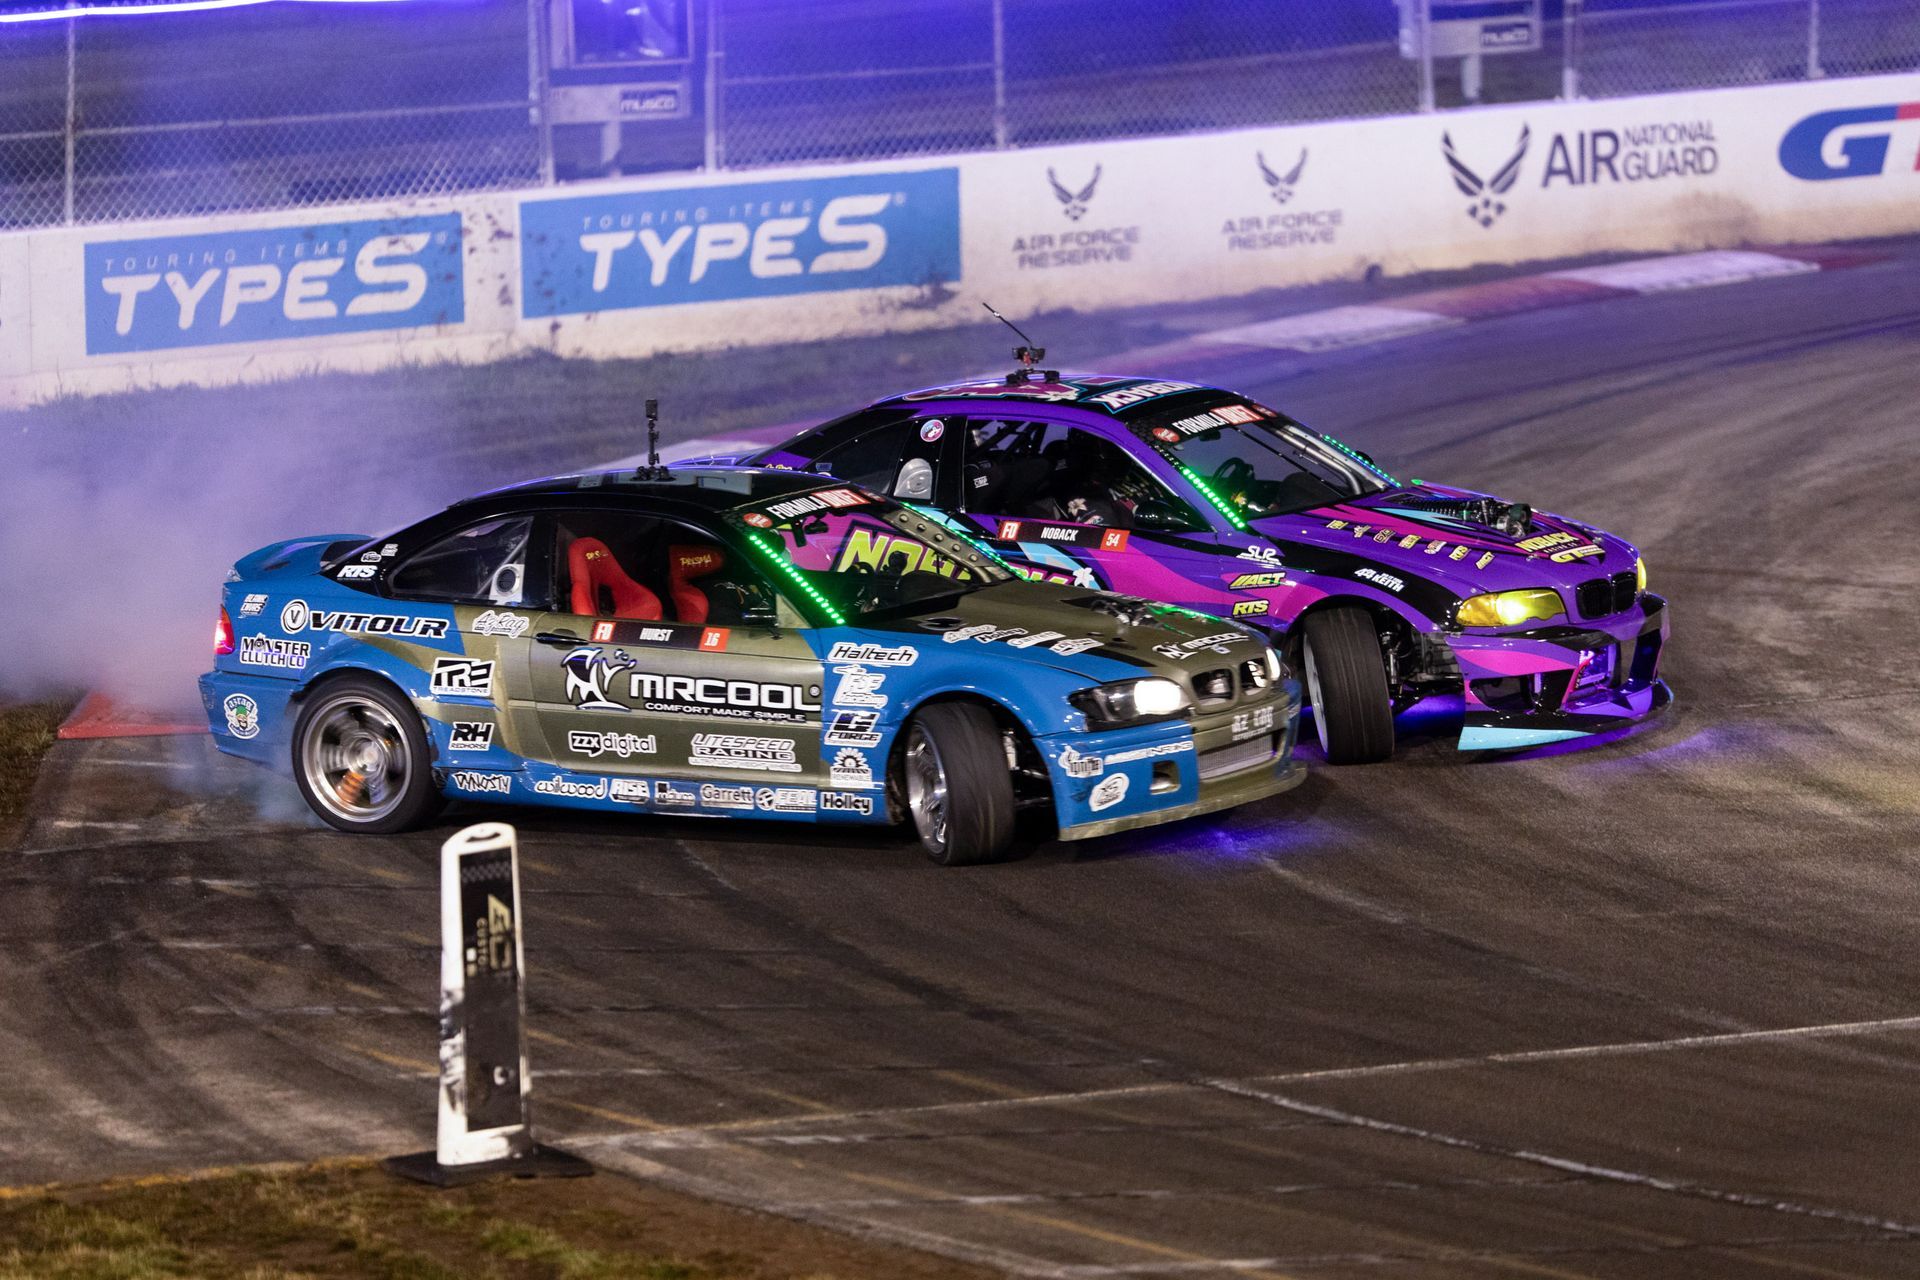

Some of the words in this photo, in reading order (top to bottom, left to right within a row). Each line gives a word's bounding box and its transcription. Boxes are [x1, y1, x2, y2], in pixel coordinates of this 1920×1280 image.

[1624, 120, 1716, 149] NATIONAL
[1542, 126, 1621, 188] AIR
[1622, 145, 1719, 181] GUARD
[583, 208, 710, 231] TOURING
[729, 198, 815, 219] ITEMS
[1220, 214, 1264, 236] AIR
[1267, 208, 1344, 230] FORCE
[1011, 232, 1056, 254] AIR
[1060, 225, 1141, 249] FORCE
[1227, 227, 1337, 252] RESERVE
[106, 250, 237, 272] TOURING
[260, 238, 349, 263] ITEMS
[1018, 243, 1133, 270] RESERVE
[1171, 411, 1230, 436] FORMULA
[1211, 404, 1262, 425] DRIFT
[766, 496, 832, 520] FORMULA
[814, 488, 868, 508] DRIFT
[1002, 521, 1018, 539] FD
[1040, 526, 1079, 541] NOBACK
[1105, 533, 1121, 546] 54
[336, 565, 379, 578] RTS
[1372, 573, 1405, 592] KEITH
[1233, 600, 1269, 615] RTS
[311, 612, 448, 637] VITOUR
[242, 638, 310, 657] MONSTER
[640, 627, 674, 642] HURST
[704, 632, 721, 646] 16
[241, 650, 287, 666] CLUTCH
[833, 645, 913, 663] Haltech
[629, 673, 822, 712] MRCOOL
[645, 702, 711, 715] COMFORT
[712, 708, 753, 718] MADE
[753, 711, 807, 723] SIMPLE
[452, 722, 493, 743] RH
[692, 734, 795, 751] LITESPEED
[603, 733, 656, 756] digital
[695, 746, 794, 760] RACING
[536, 777, 607, 798] wilwood
[701, 784, 753, 802] Garrett
[823, 792, 872, 814] Holley
